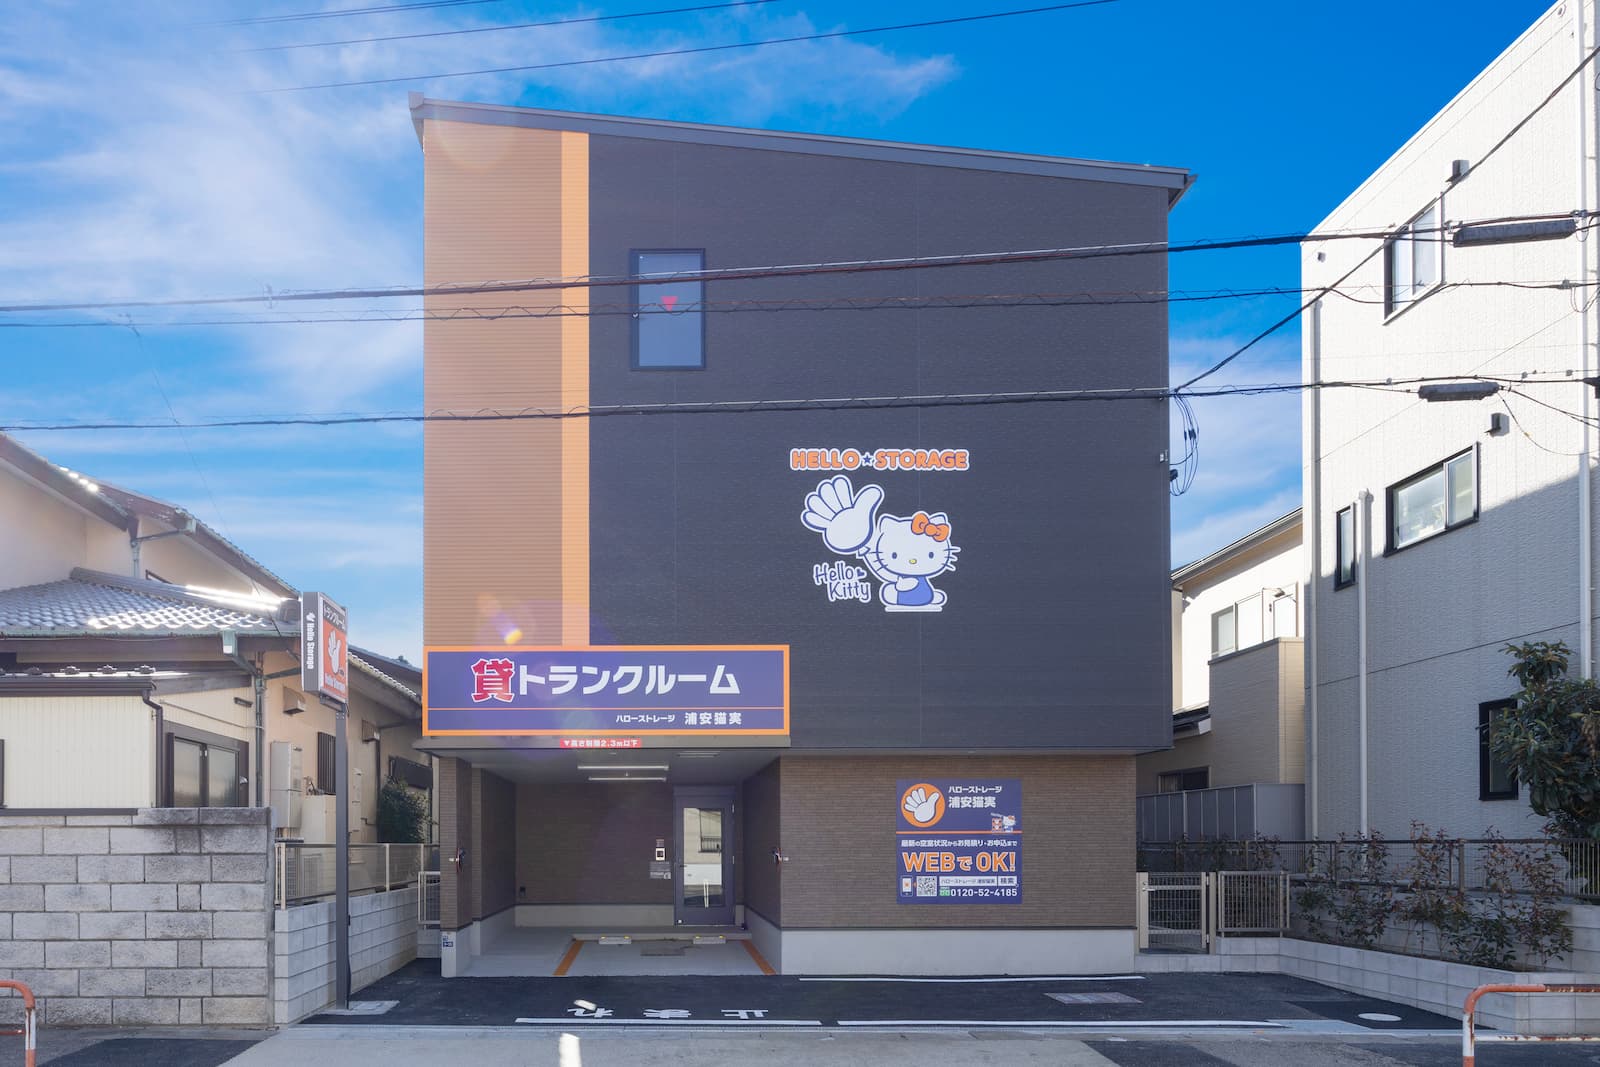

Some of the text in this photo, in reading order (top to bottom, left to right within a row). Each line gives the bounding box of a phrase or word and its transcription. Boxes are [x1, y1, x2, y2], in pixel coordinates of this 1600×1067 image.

[791, 449, 969, 470] HELLO STORAGE
[814, 562, 855, 584] Hello
[829, 582, 871, 602] Kitty
[471, 658, 740, 703] 貸トランクルーム
[616, 712, 742, 725] ハローストレージ 浦安猫実
[949, 796, 996, 808] 浦安猫実
[951, 889, 1017, 897] 0120-52-4185
